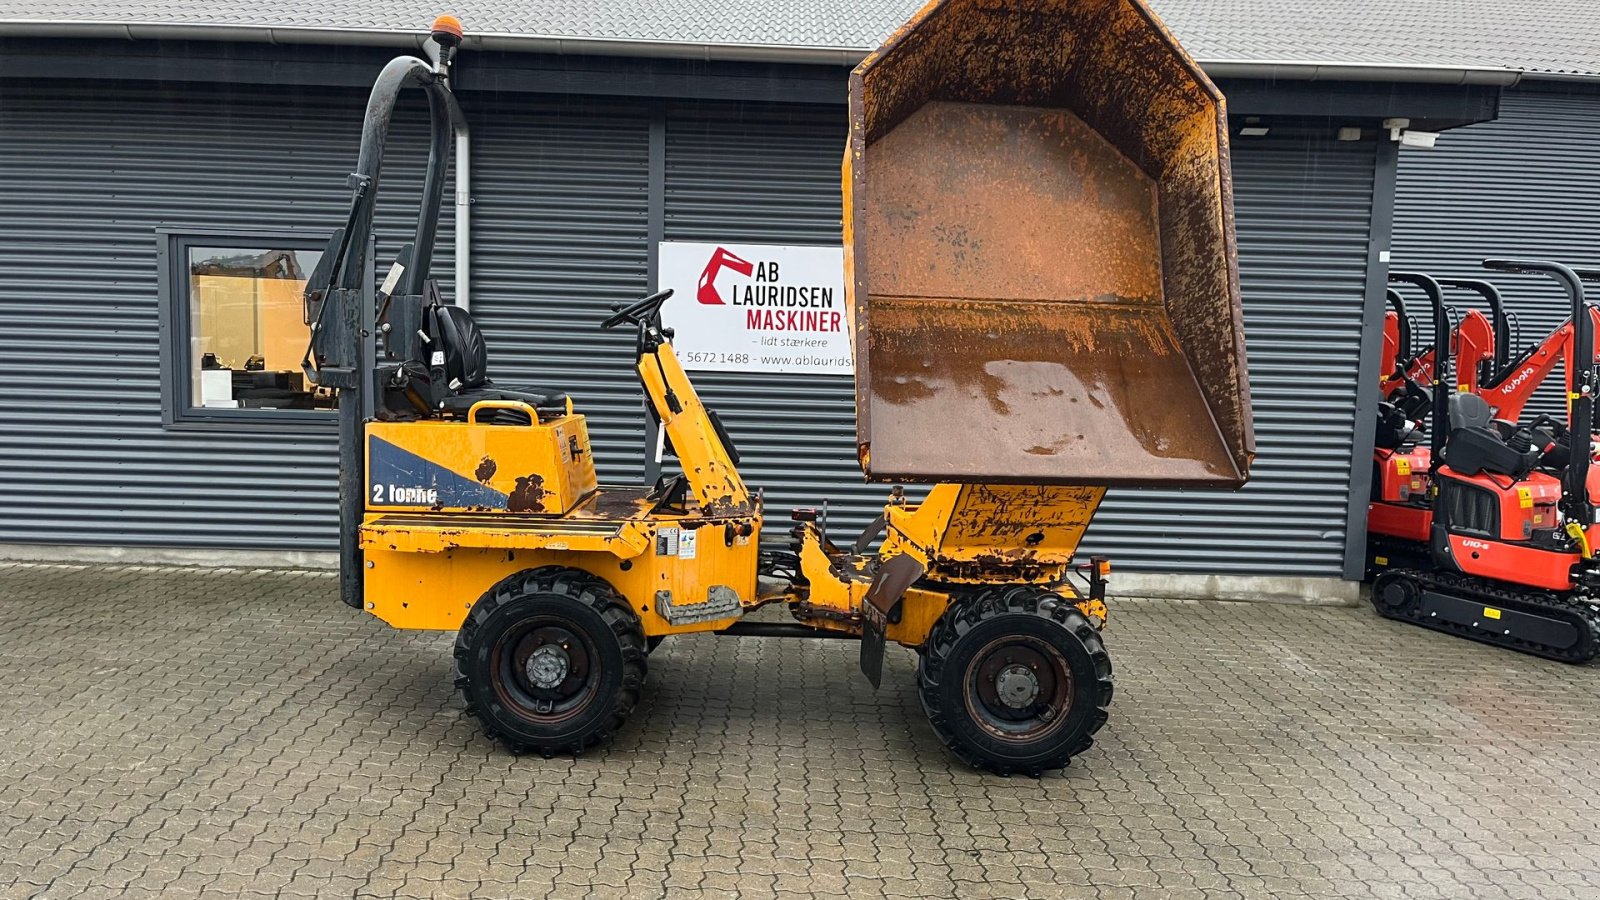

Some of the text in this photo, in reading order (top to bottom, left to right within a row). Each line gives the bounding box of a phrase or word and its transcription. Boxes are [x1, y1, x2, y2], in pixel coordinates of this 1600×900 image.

[755, 261, 780, 283] AB
[732, 285, 833, 308] LAURIDSEN
[746, 309, 841, 333] MASKINER
[760, 336, 778, 346] lidt
[780, 337, 828, 348] stærkere
[687, 351, 716, 363] 5672
[719, 353, 749, 364] 1488
[1501, 367, 1534, 395] Kubota
[372, 483, 438, 504] 2 tonne
